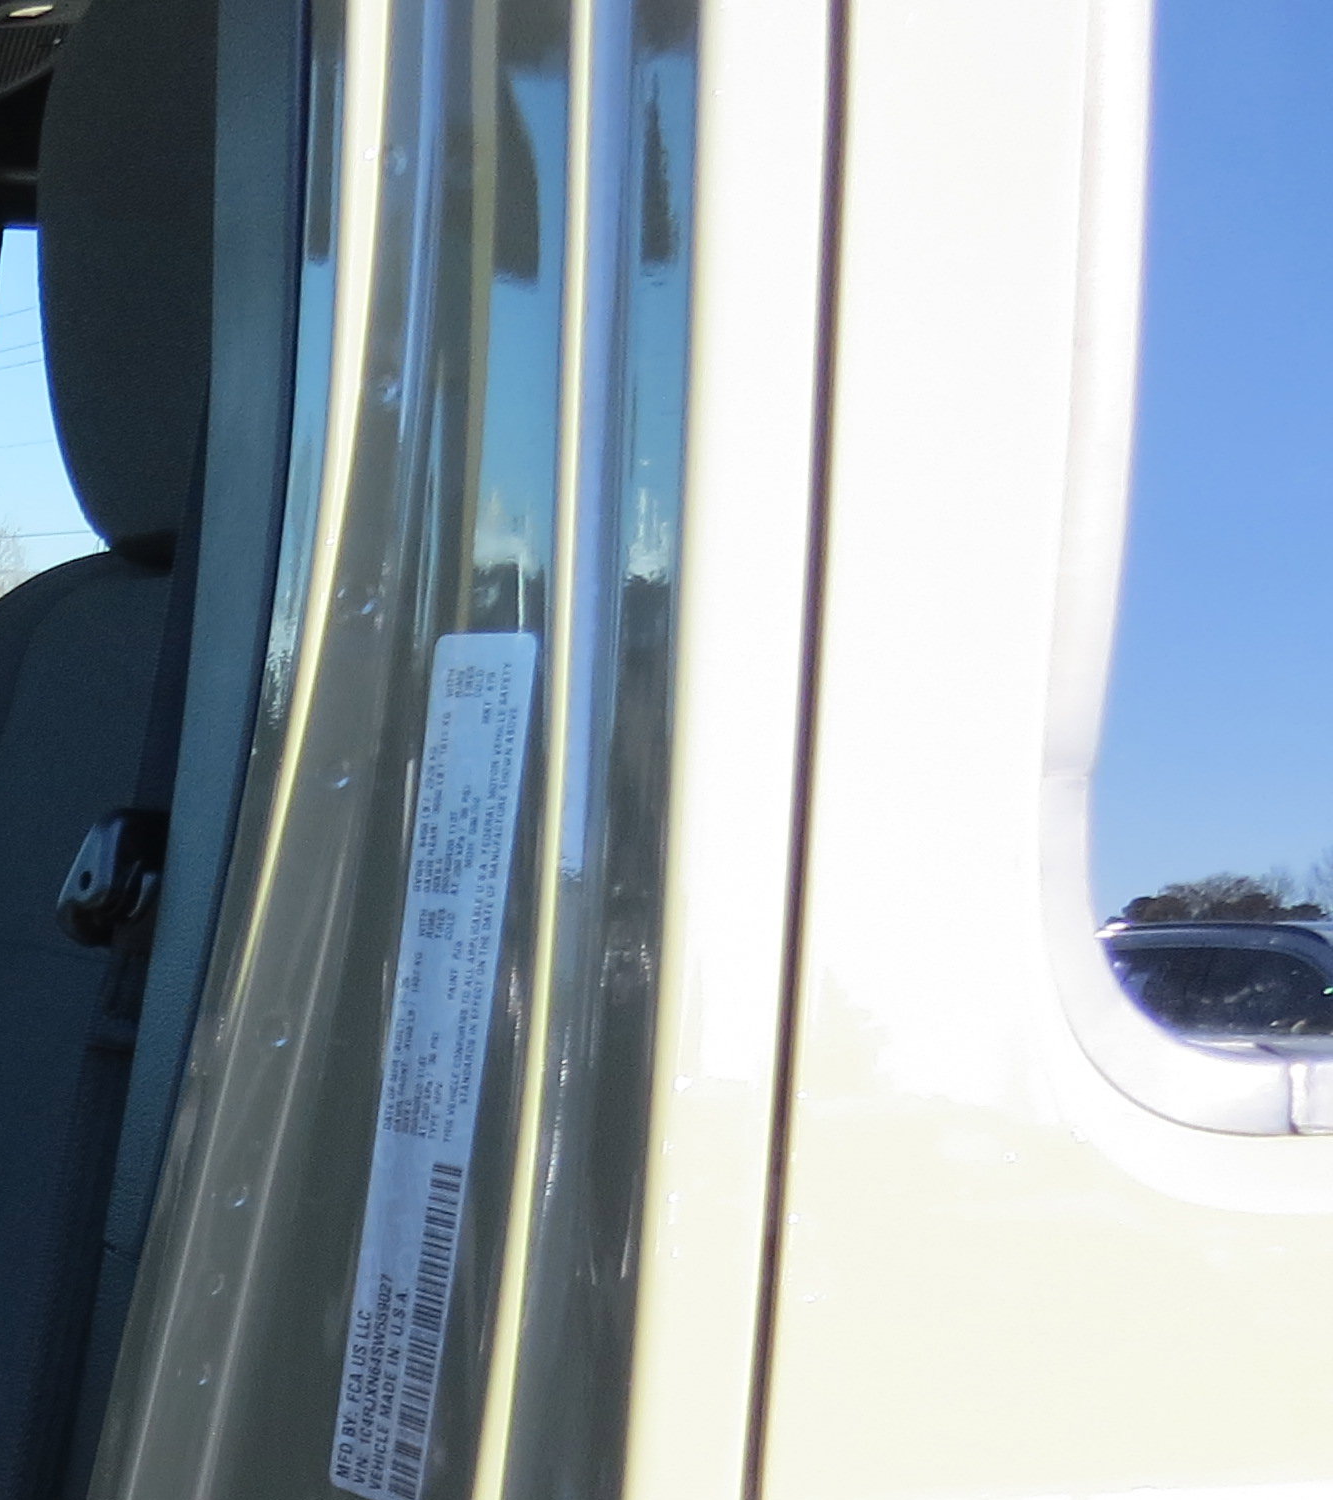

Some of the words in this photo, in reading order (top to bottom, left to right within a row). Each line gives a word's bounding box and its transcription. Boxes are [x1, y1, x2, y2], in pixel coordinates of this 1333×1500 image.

[355, 1308, 372, 1341] LLC
[391, 1284, 409, 1338] U.S.A.
[351, 1342, 367, 1369] US
[346, 1370, 363, 1405] FCA
[379, 1369, 397, 1420] MADE
[342, 1408, 358, 1440] BY:
[336, 1440, 353, 1480] MFD
[369, 1423, 390, 1493] VEHICLE
